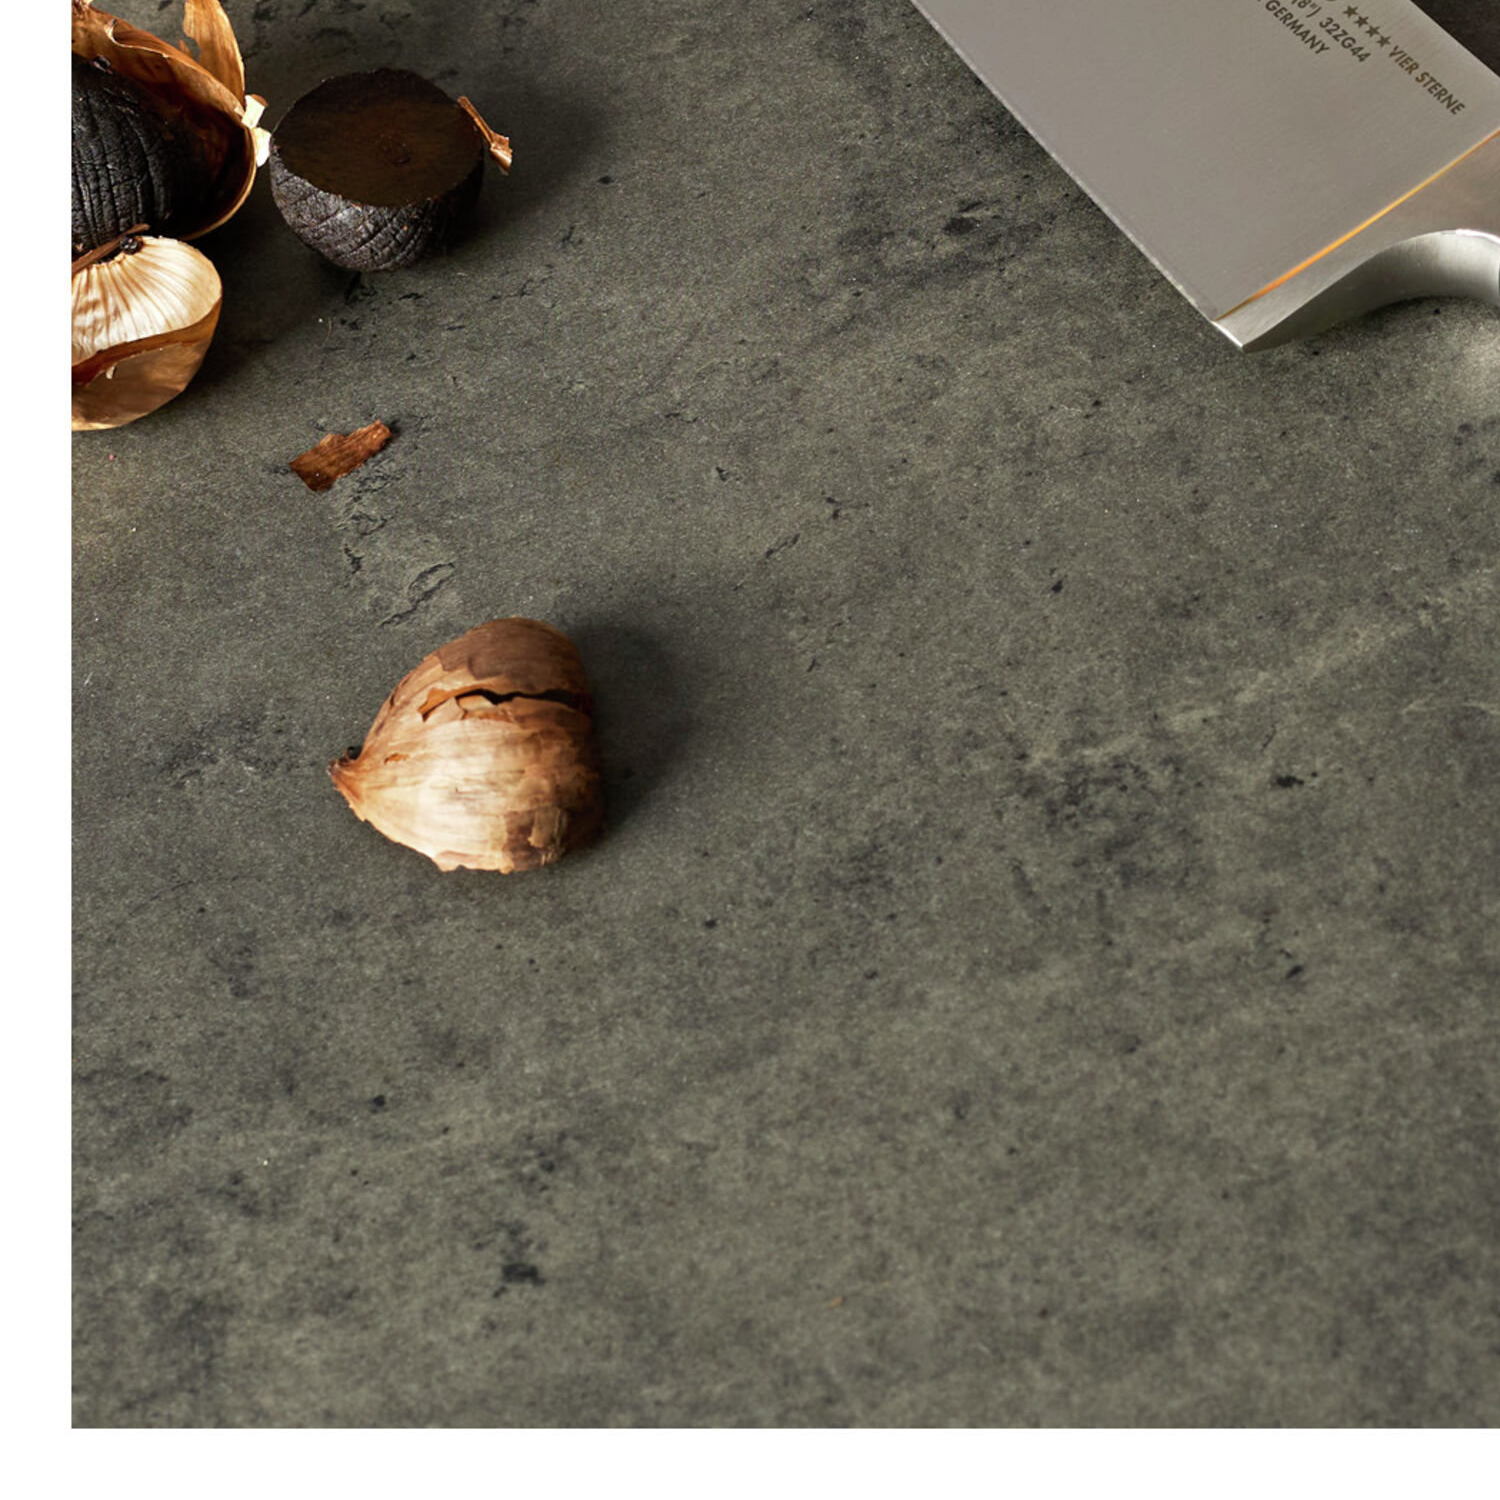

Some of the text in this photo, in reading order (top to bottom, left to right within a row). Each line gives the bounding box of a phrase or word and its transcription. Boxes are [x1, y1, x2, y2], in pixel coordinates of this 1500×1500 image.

[1266, 0, 1330, 55] GERMANY
[1319, 17, 1371, 63] 32ZG44
[1388, 45, 1419, 74] VIER
[1415, 71, 1467, 115] STERNE
